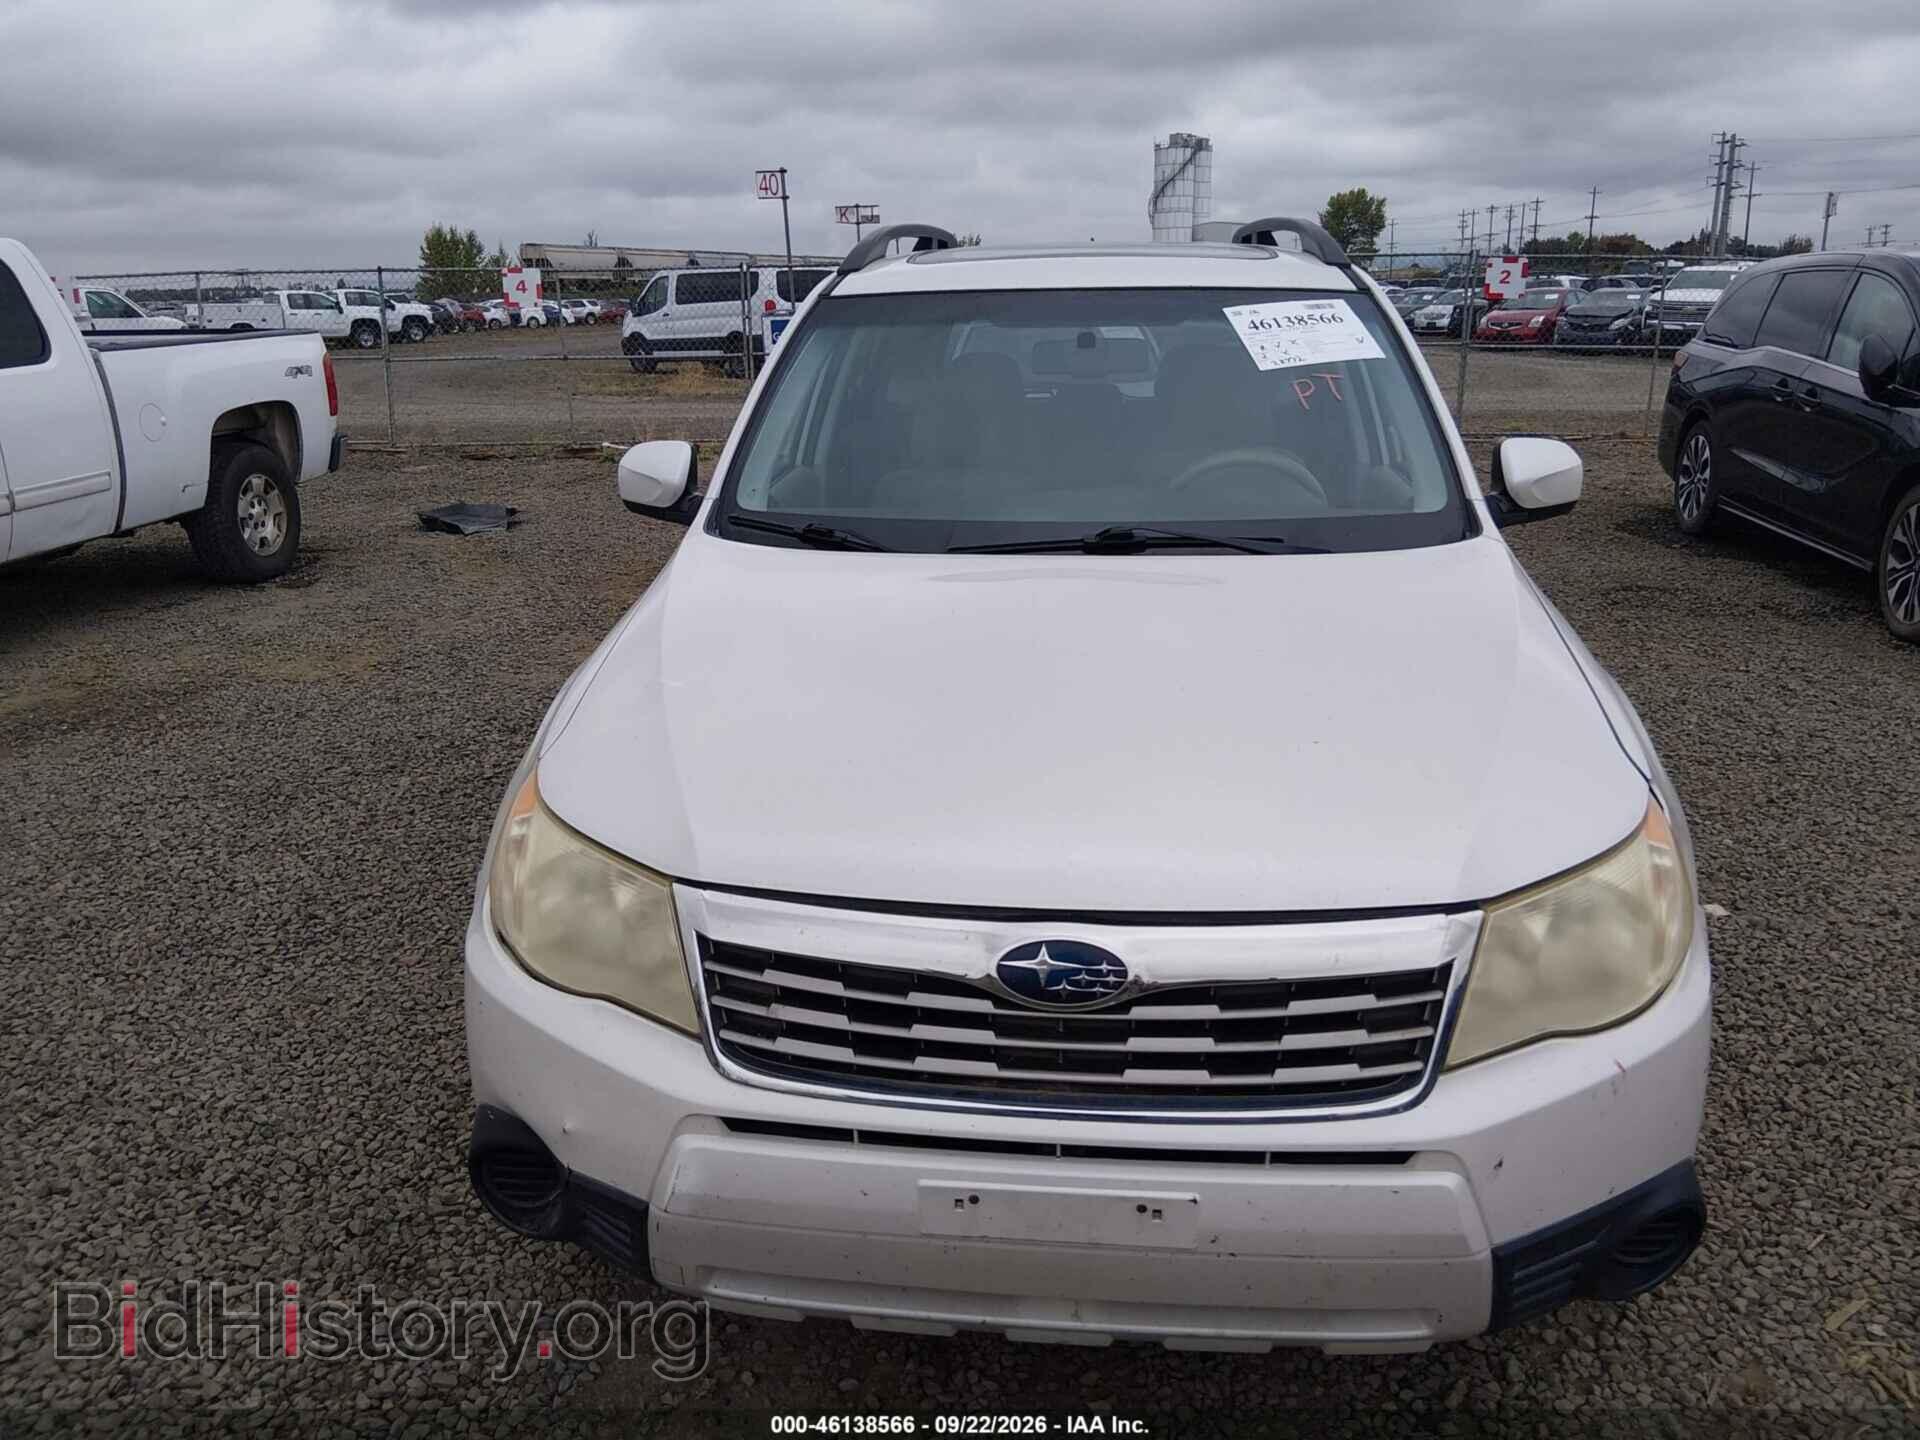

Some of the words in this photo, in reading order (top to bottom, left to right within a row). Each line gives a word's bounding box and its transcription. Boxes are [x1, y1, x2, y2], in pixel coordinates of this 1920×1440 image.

[759, 174, 779, 196] 40
[1499, 270, 1511, 284] 2
[516, 280, 528, 294] 4
[1248, 313, 1344, 331] 46138566
